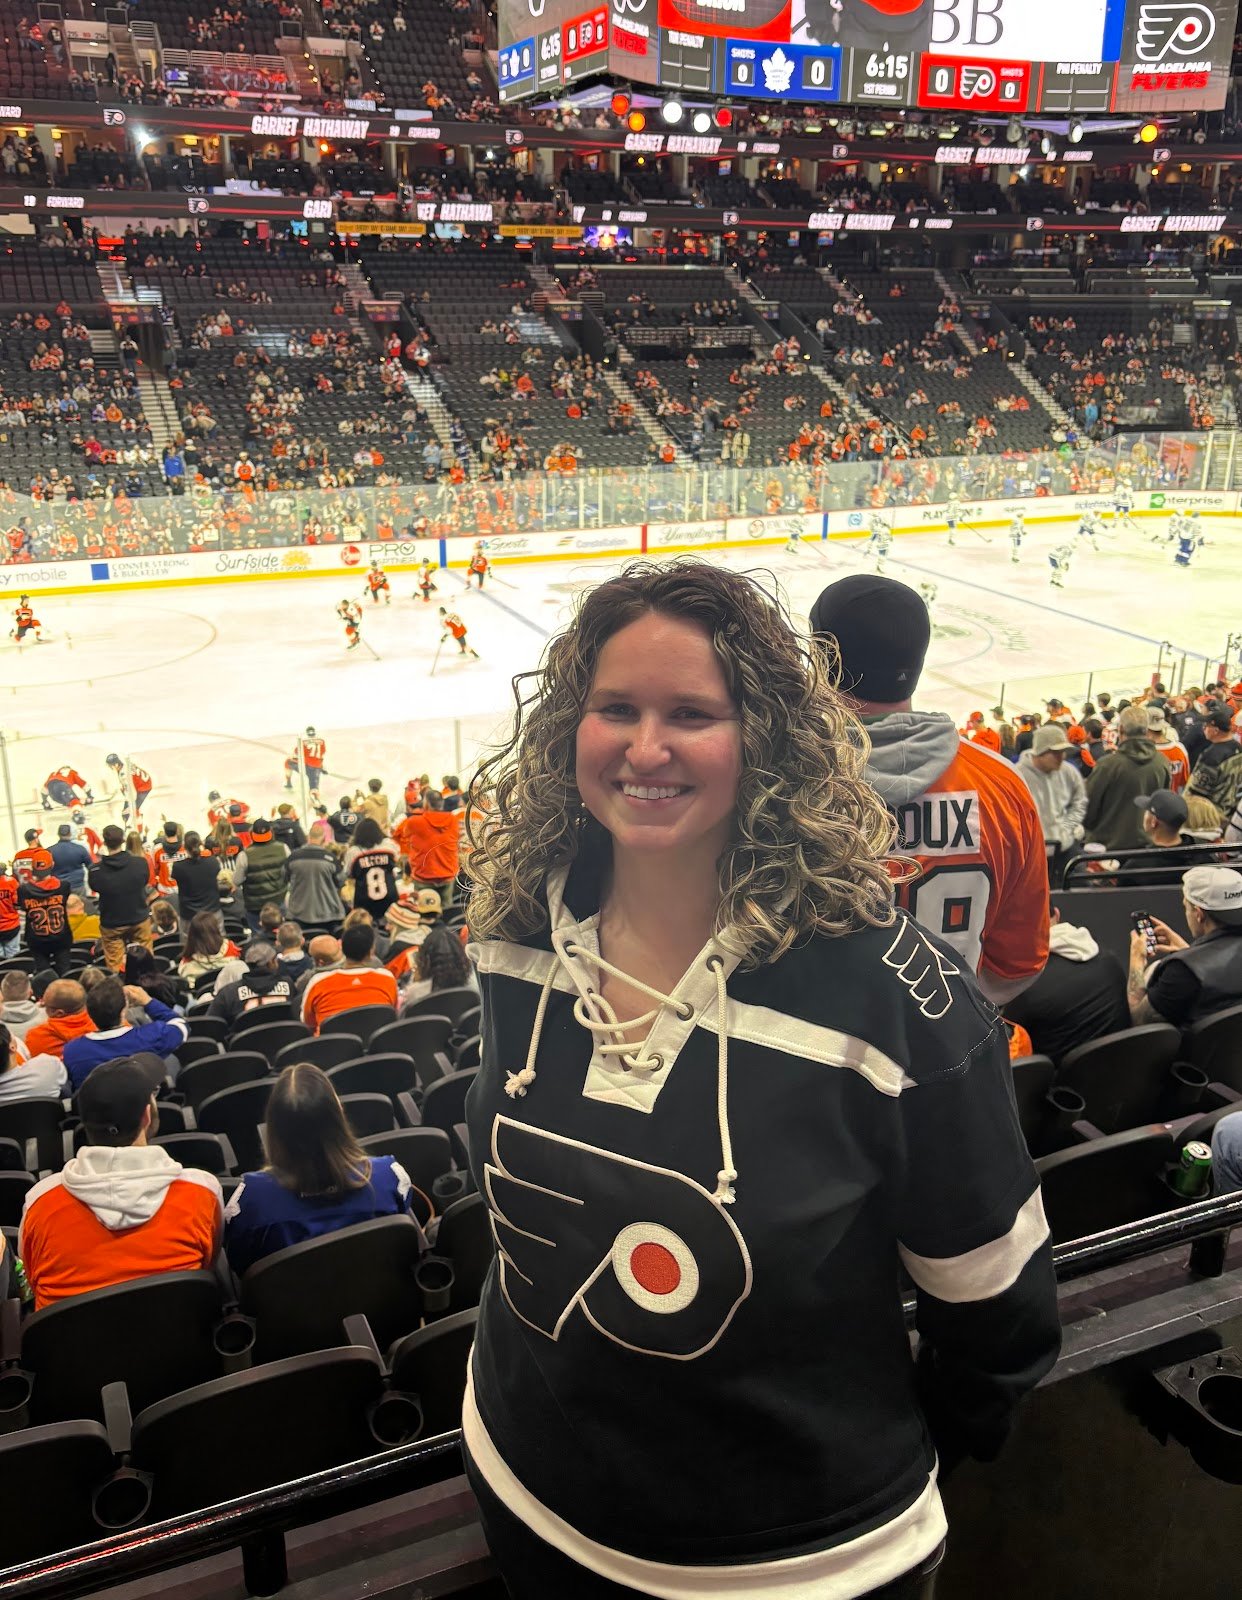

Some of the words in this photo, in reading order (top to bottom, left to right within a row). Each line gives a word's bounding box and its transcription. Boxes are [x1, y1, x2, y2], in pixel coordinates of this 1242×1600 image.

[811, 60, 825, 85] 0
[866, 53, 909, 79] 6:15
[1132, 62, 1212, 74] PHILADELPHIA
[935, 69, 949, 92] 0
[1130, 73, 1211, 91] FLYERS
[251, 115, 299, 137] GARNET
[303, 118, 370, 139] HATHAWAY
[216, 553, 279, 572] Surfside
[16, 568, 68, 583] mobile
[366, 867, 388, 900] 8
[28, 904, 65, 936] 20
